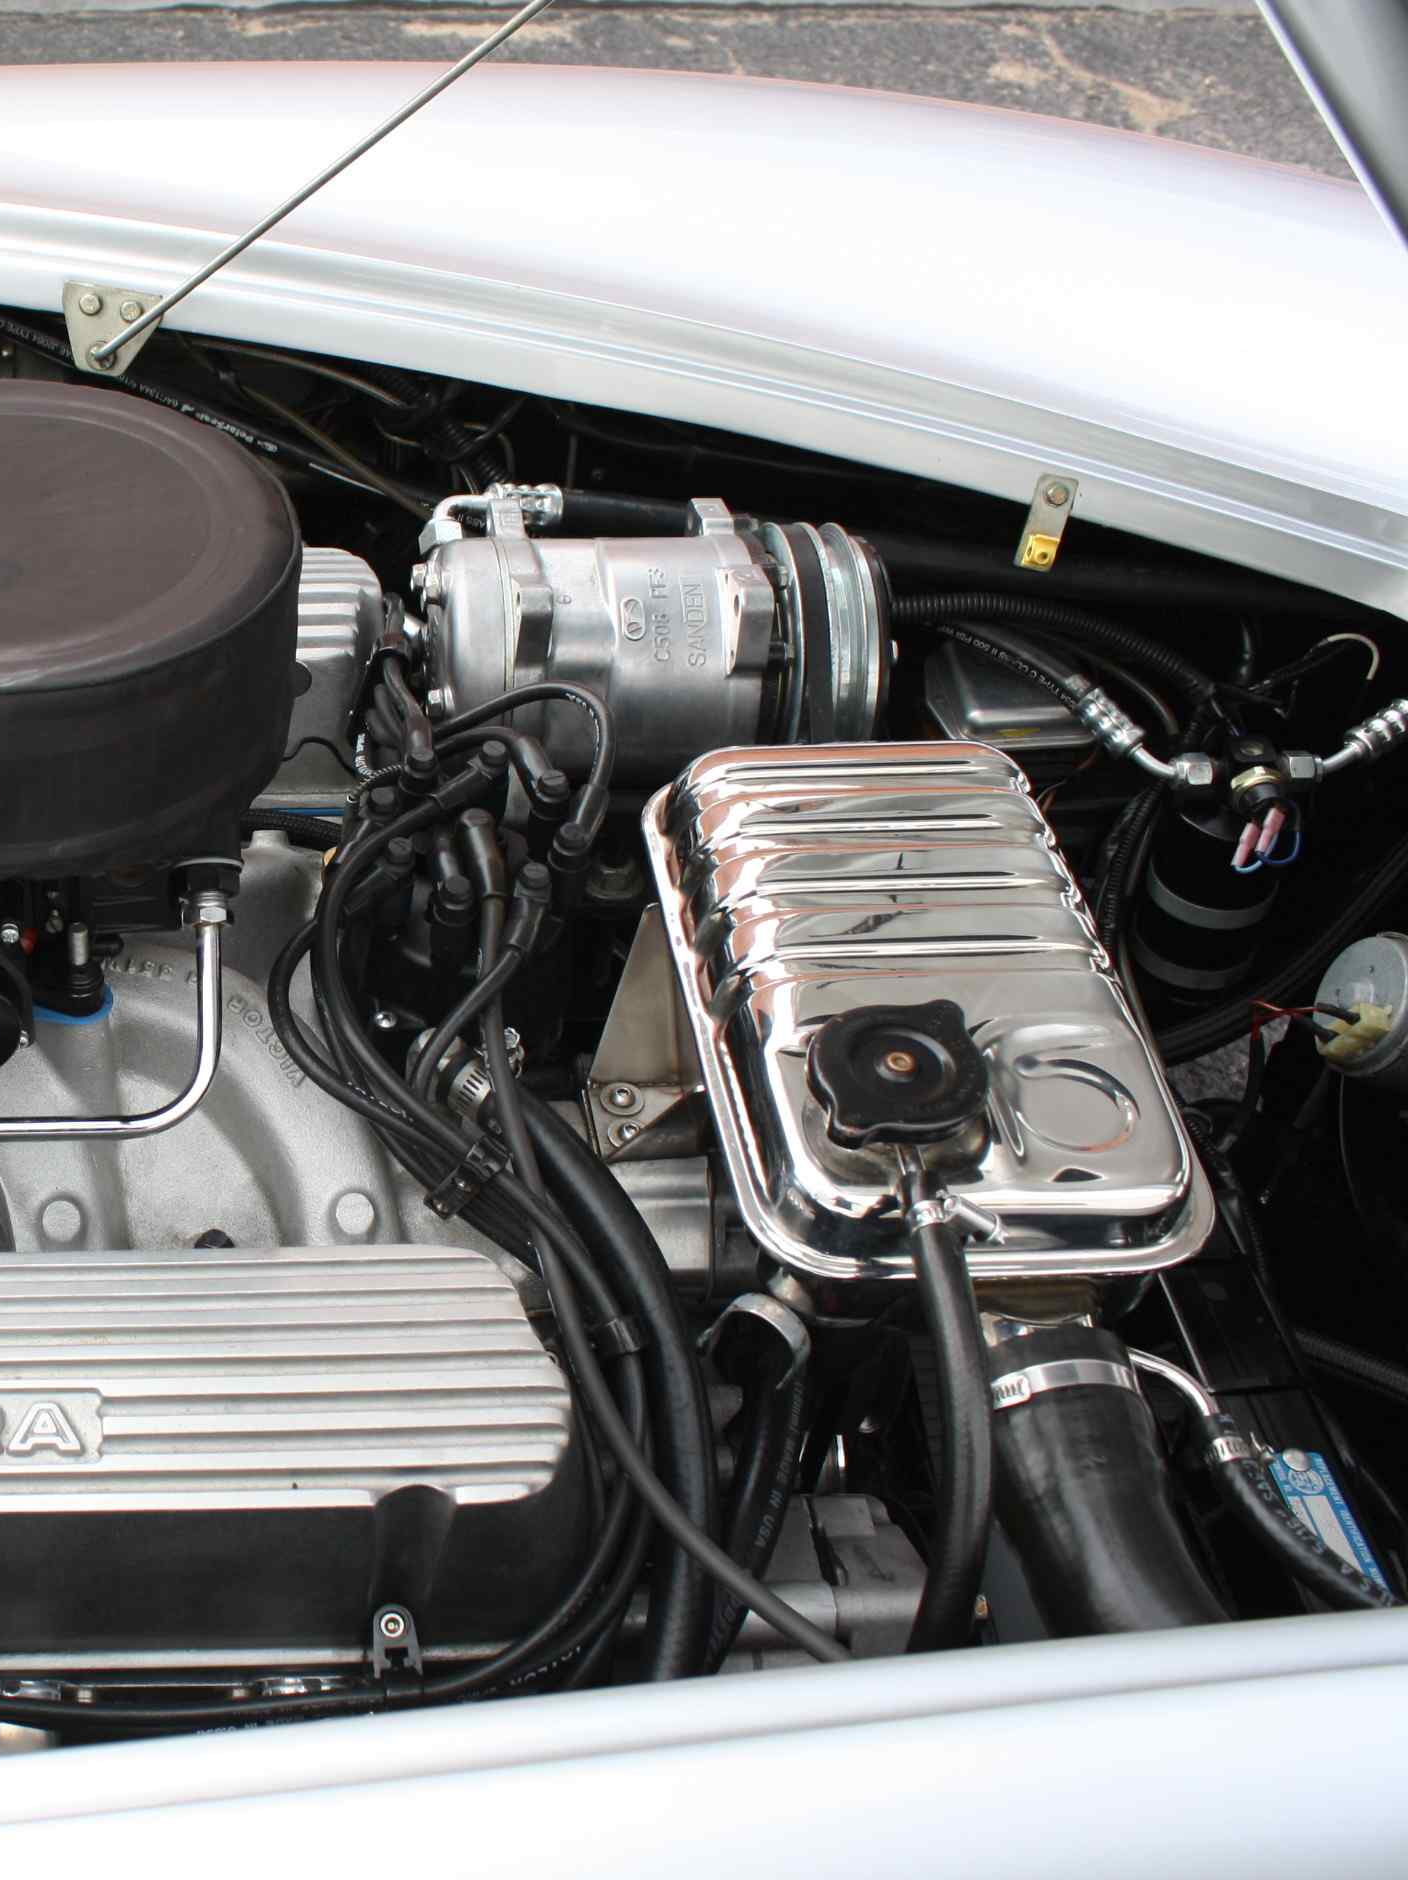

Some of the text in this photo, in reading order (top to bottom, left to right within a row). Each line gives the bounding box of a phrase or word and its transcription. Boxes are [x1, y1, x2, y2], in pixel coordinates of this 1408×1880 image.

[685, 583, 705, 667] SANDEN
[973, 638, 991, 653] 500
[226, 993, 308, 1089] VICTOR
[754, 1513, 776, 1549] USA
